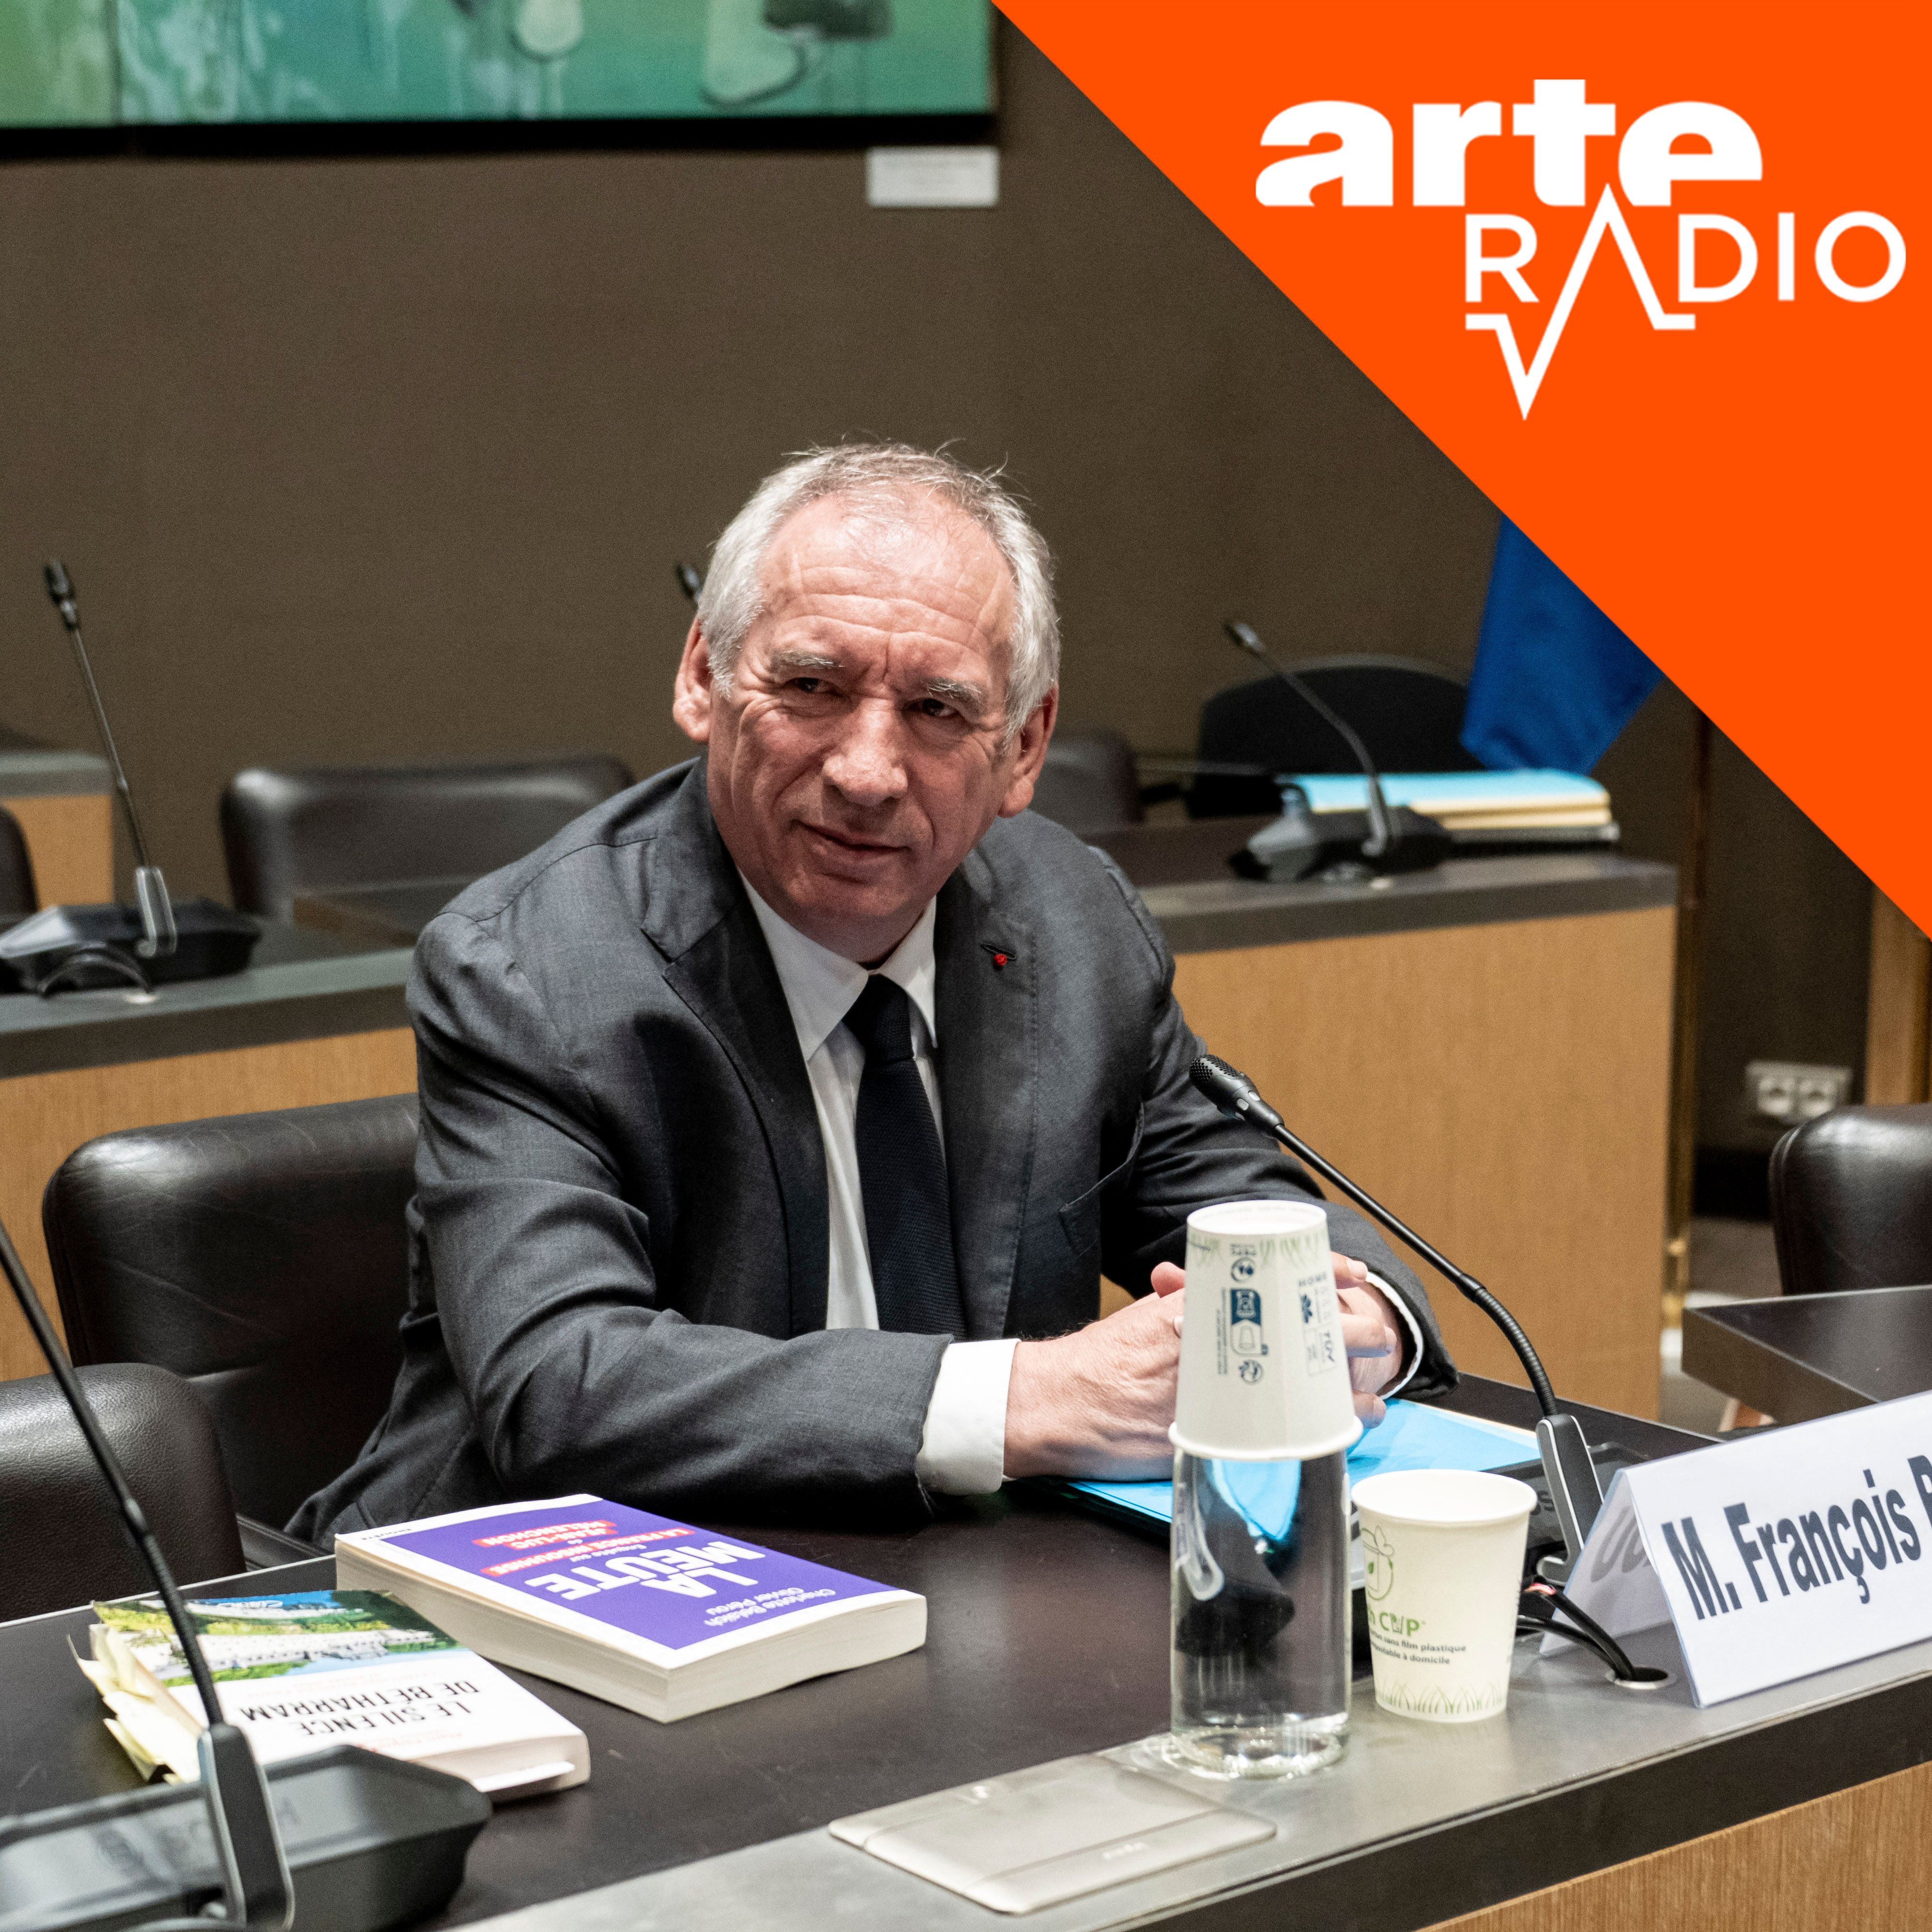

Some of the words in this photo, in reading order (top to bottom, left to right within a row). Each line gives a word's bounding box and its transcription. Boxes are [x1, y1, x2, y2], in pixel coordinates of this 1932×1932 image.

[510, 1528, 607, 1549] JEAN-LUC
[589, 1533, 664, 1550] FRANCE
[658, 1528, 689, 1537] LA
[1661, 1516, 1743, 1621] M.
[1723, 1468, 1921, 1604] François
[489, 1545, 592, 1574] INSOUMISE
[525, 1541, 766, 1600] MEUTE
[640, 1566, 759, 1598] LA
[754, 1587, 804, 1602] Olivier
[762, 1588, 836, 1609] Charlotte
[1421, 1643, 1466, 1653] plastique
[1410, 1655, 1450, 1664] domicile
[439, 1680, 481, 1696] DE
[426, 1701, 472, 1717] LE
[297, 1706, 426, 1736] SILENCE
